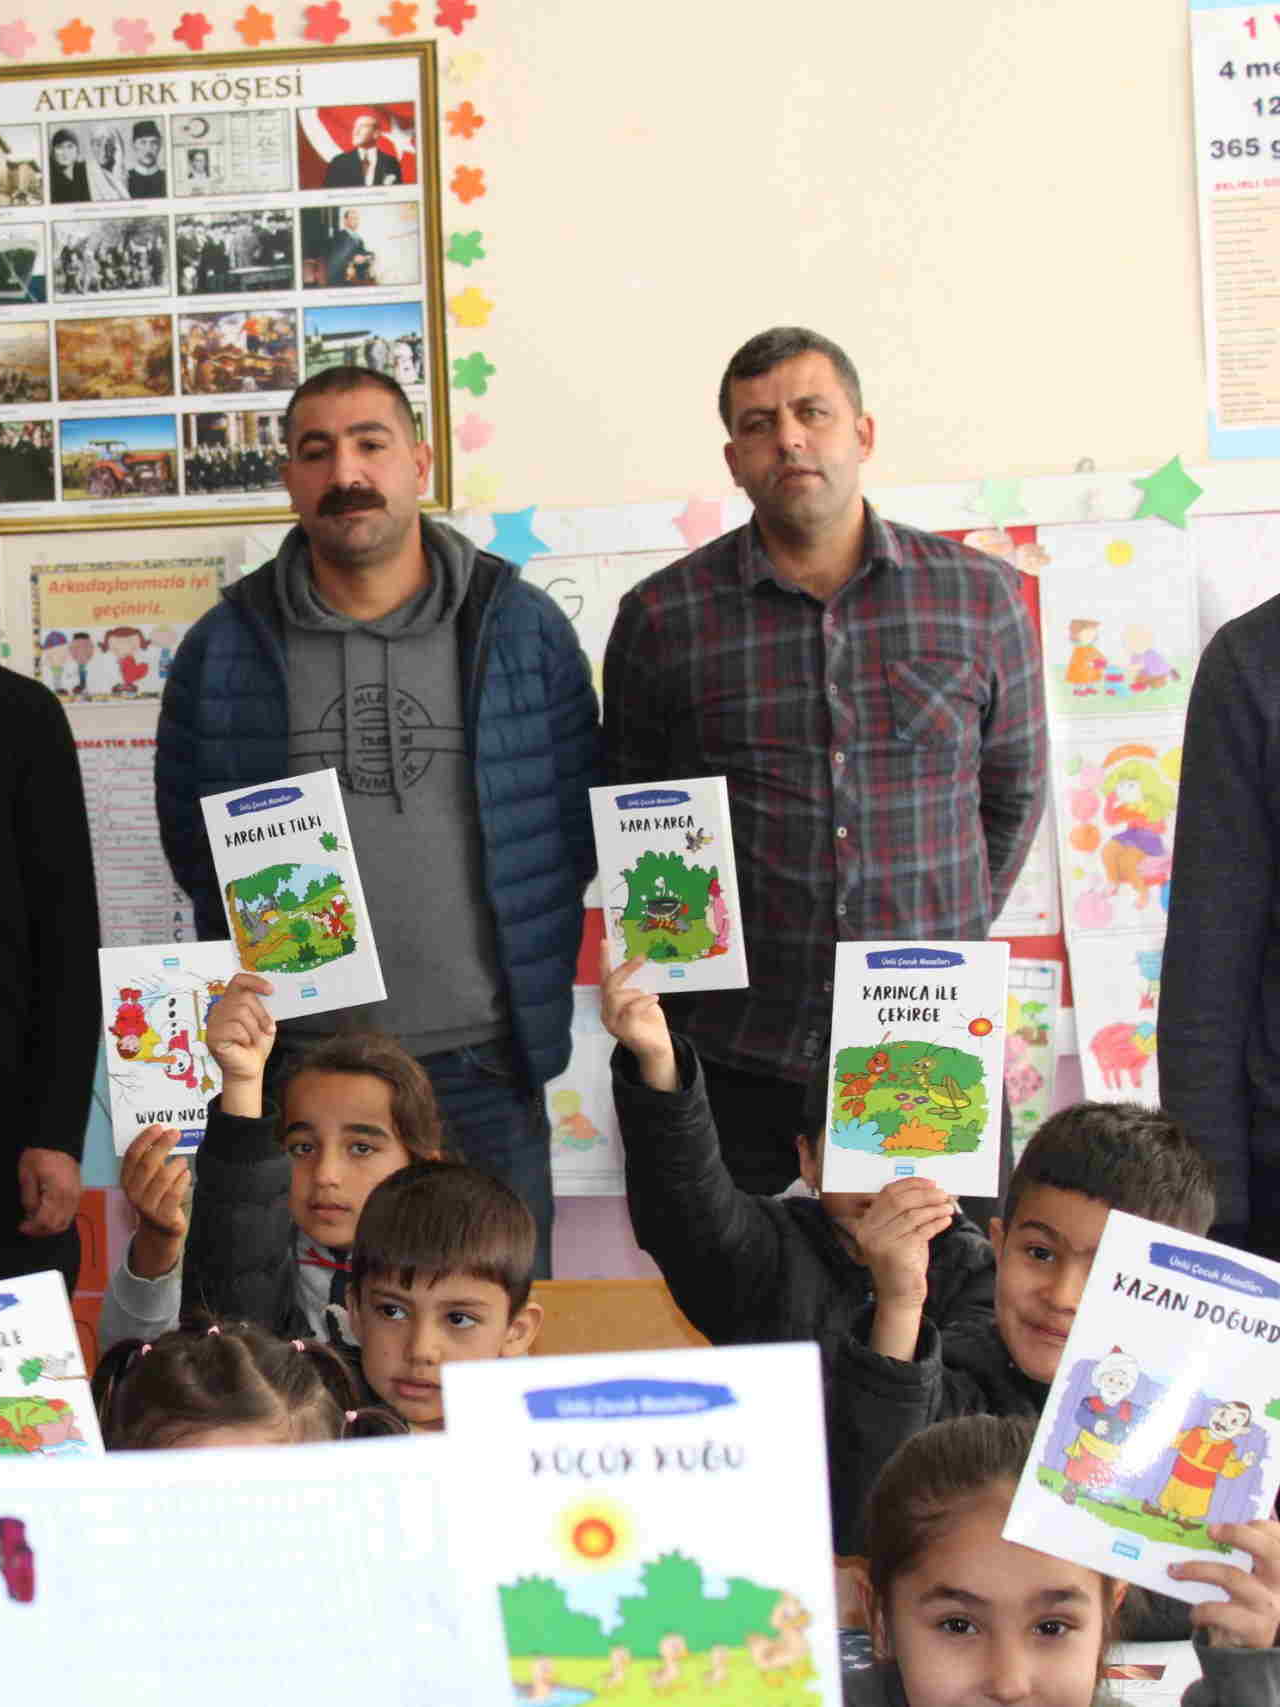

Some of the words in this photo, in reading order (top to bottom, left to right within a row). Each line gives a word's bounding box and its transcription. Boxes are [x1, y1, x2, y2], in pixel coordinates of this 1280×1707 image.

[1219, 60, 1235, 80] 4
[34, 77, 178, 113] ATATÜRK
[190, 67, 304, 107] KÖŞESİ
[1210, 137, 1261, 160] 365
[620, 818, 652, 833] KARA
[654, 815, 695, 831] KARGA
[224, 825, 266, 848] KARGA
[862, 984, 929, 1001] KARINCA
[877, 1005, 941, 1026] ÇEKİRGE
[1113, 1272, 1190, 1311] KAZAN
[1193, 1299, 1280, 1345] DOĞURD
